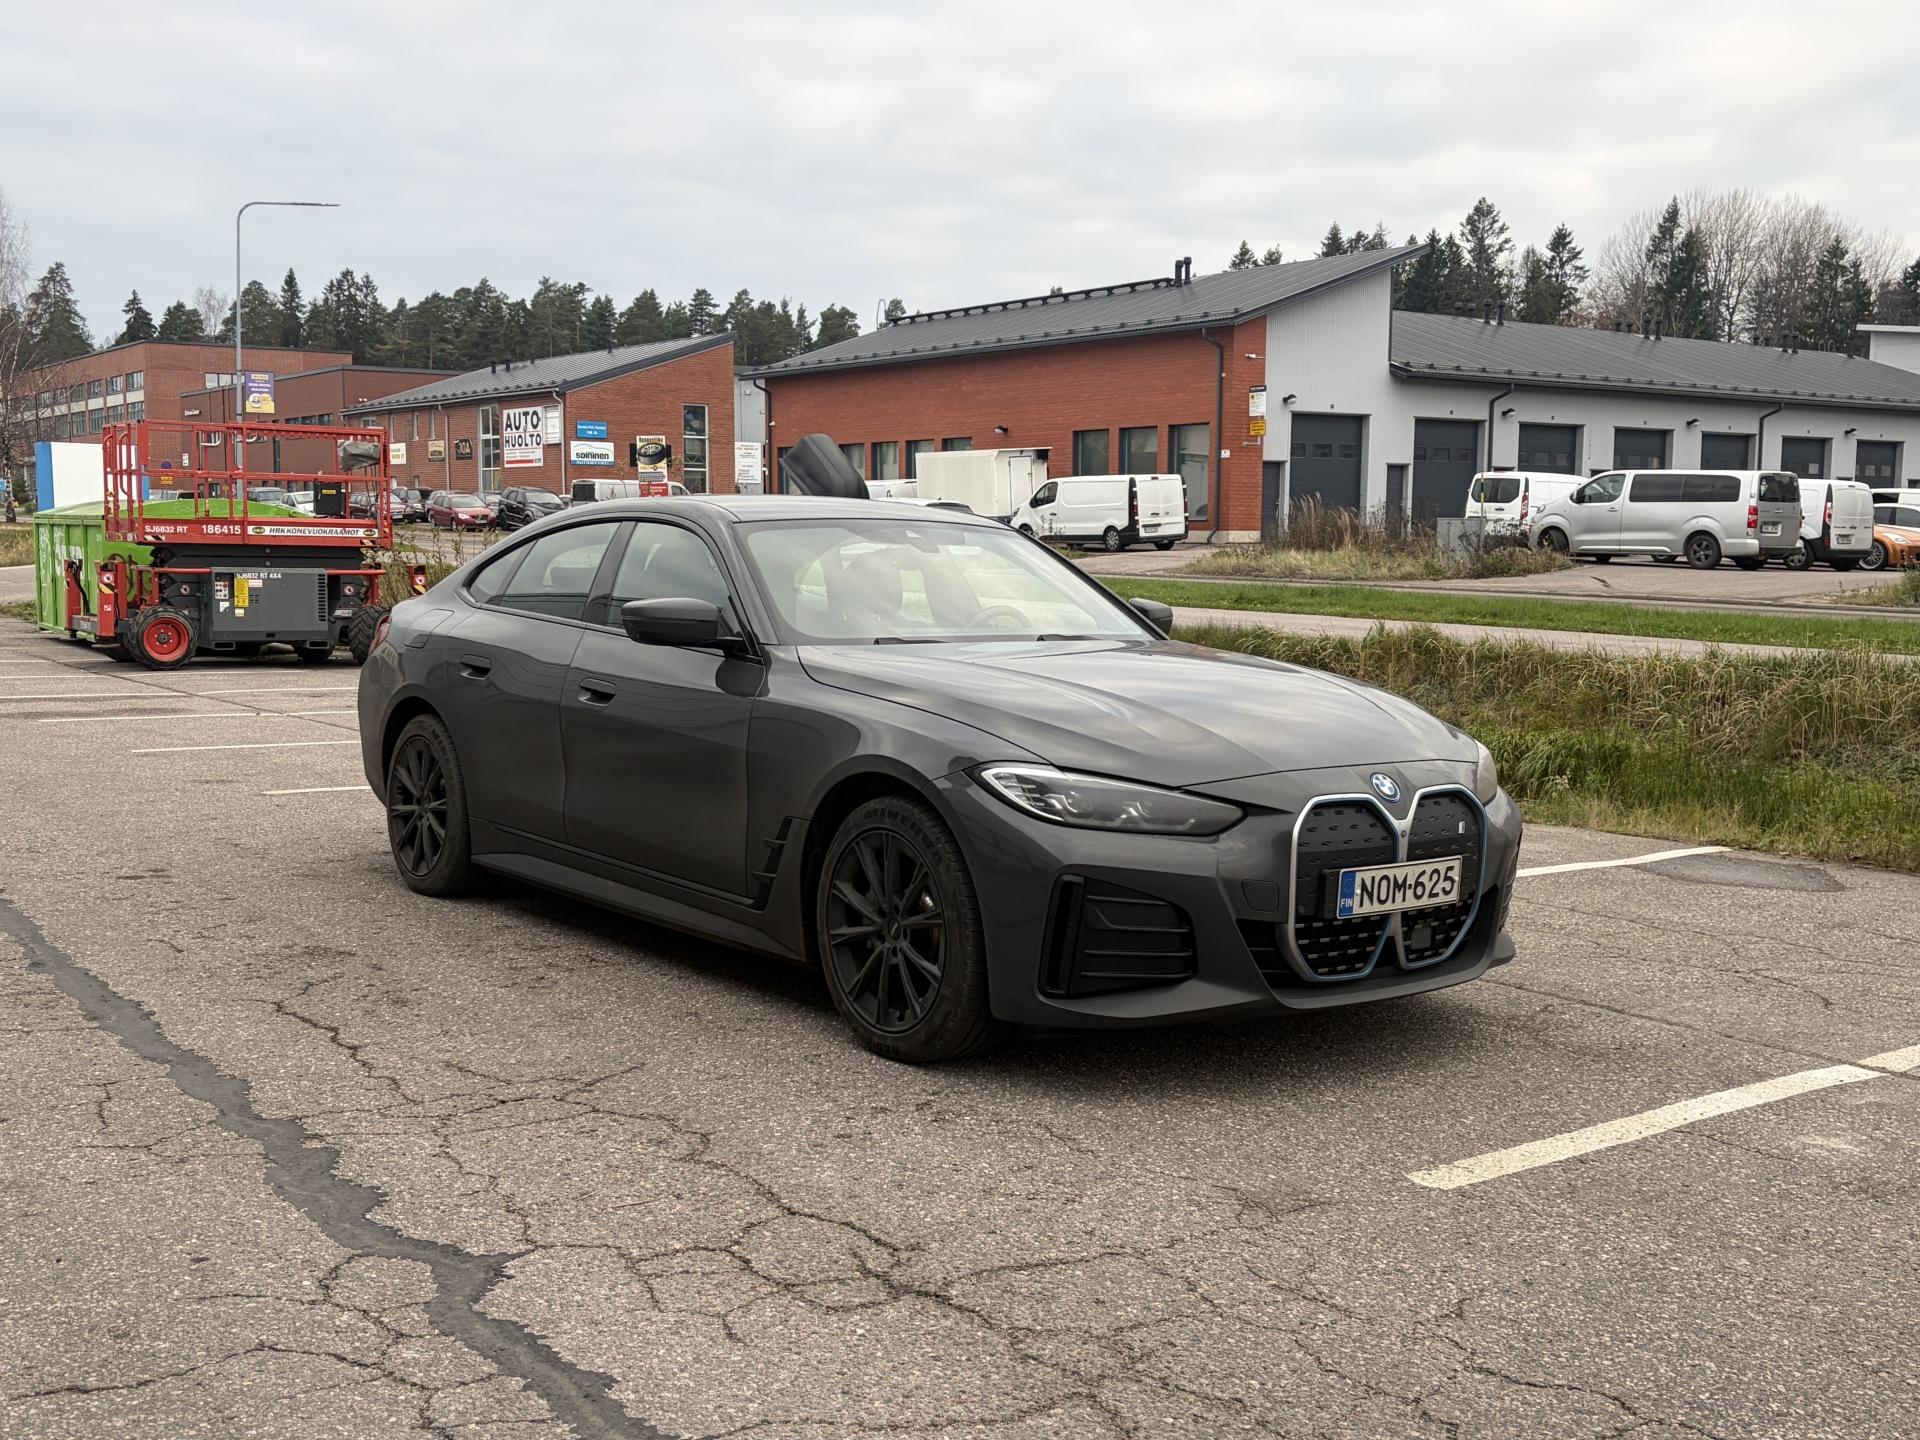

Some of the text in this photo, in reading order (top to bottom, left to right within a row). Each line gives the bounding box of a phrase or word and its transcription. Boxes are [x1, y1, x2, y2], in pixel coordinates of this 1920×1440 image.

[505, 433, 542, 449] HUOLTO
[575, 451, 610, 460] soininen
[144, 525, 188, 533] SJ6832 RT
[201, 524, 242, 535] 186415
[286, 528, 360, 536] KONEVUOKRAAMOT
[1359, 865, 1455, 908] NOM-625
[1340, 897, 1353, 908] FIN
